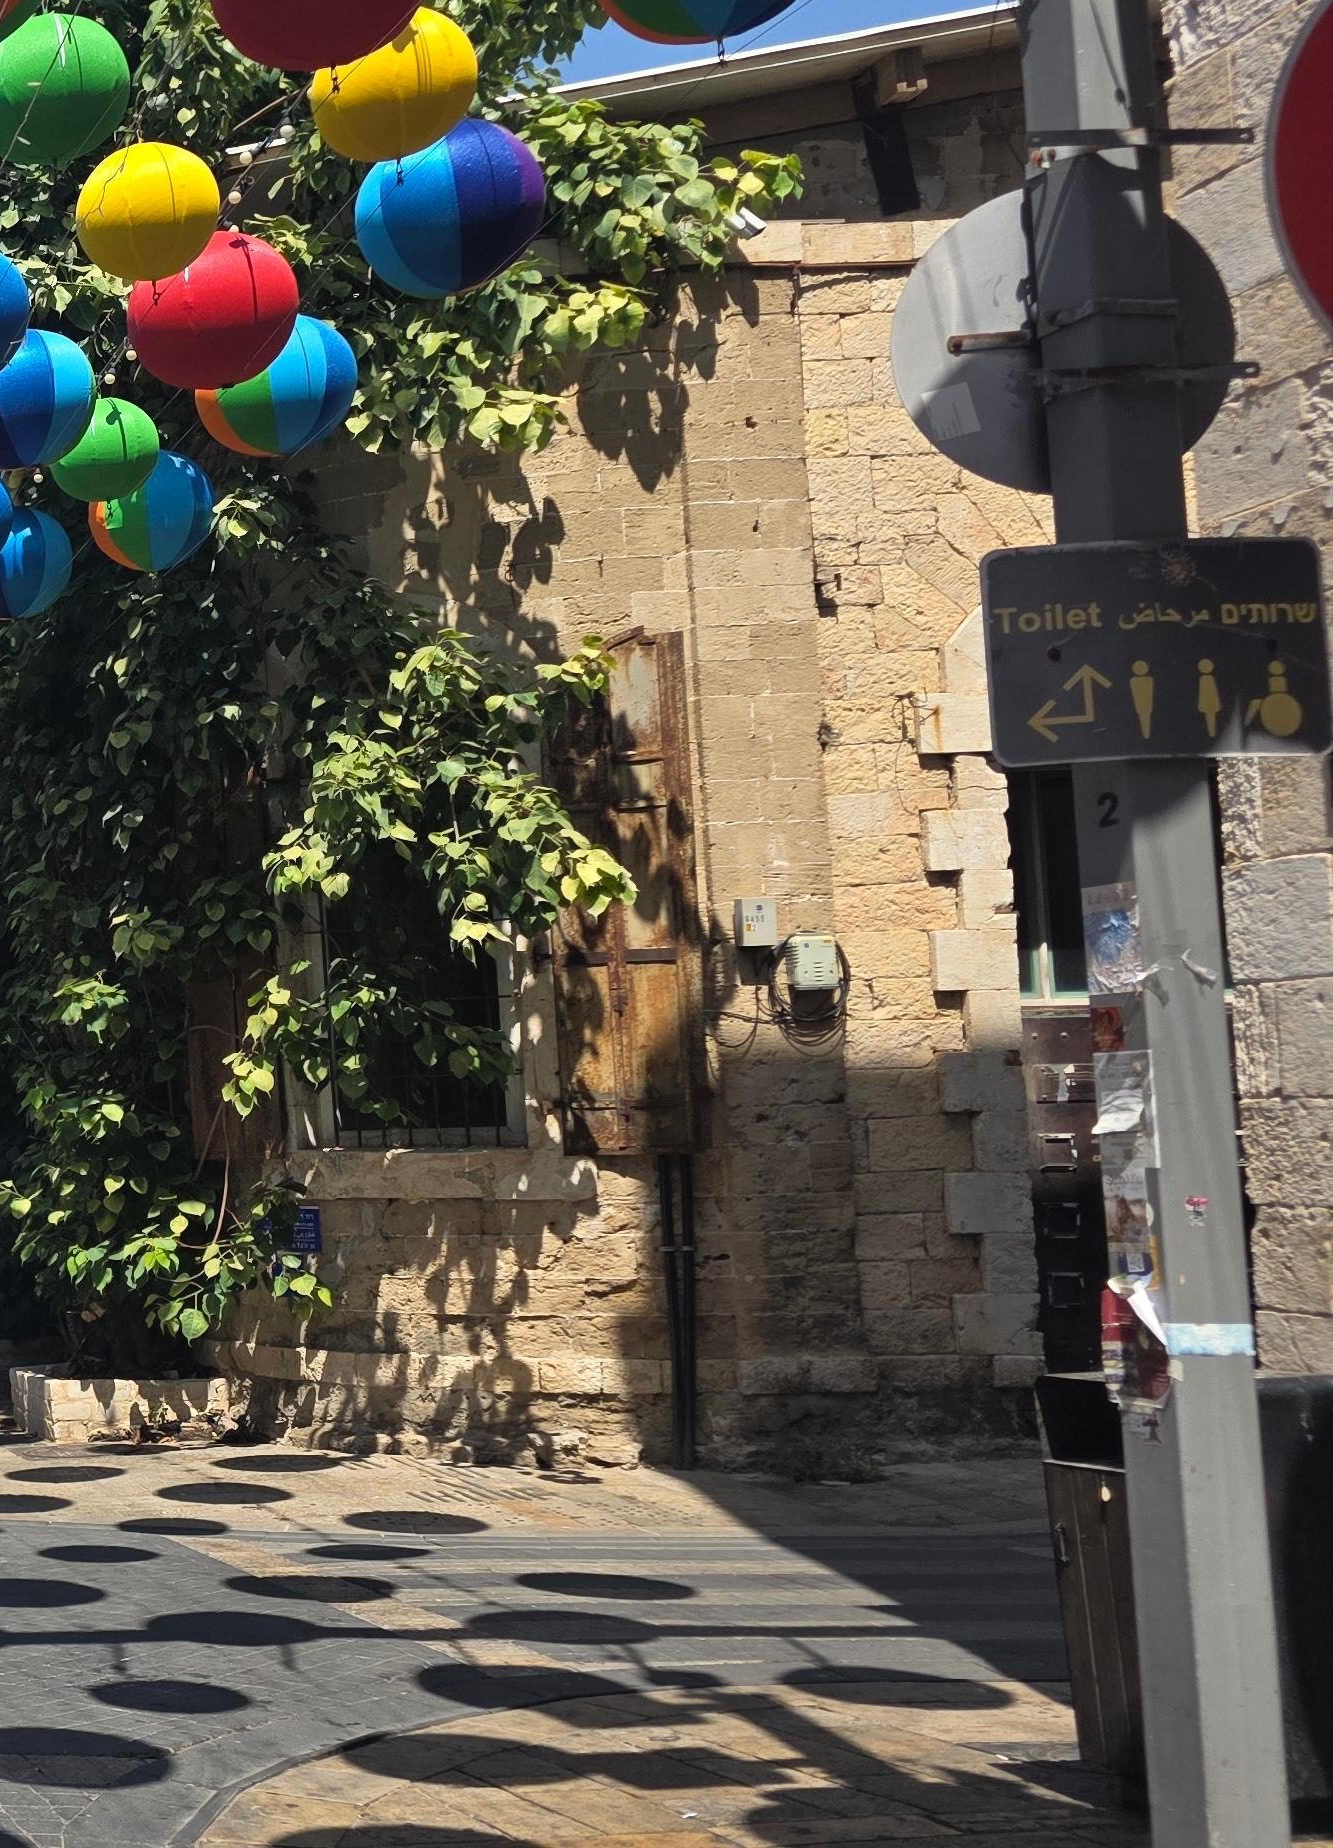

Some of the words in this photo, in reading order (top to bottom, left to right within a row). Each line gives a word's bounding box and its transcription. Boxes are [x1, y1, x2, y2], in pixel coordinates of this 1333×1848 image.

[994, 602, 1102, 634] Toilet
[1118, 602, 1209, 629] مرحاض
[1220, 602, 1316, 624] שרותים
[1097, 792, 1120, 828] 2
